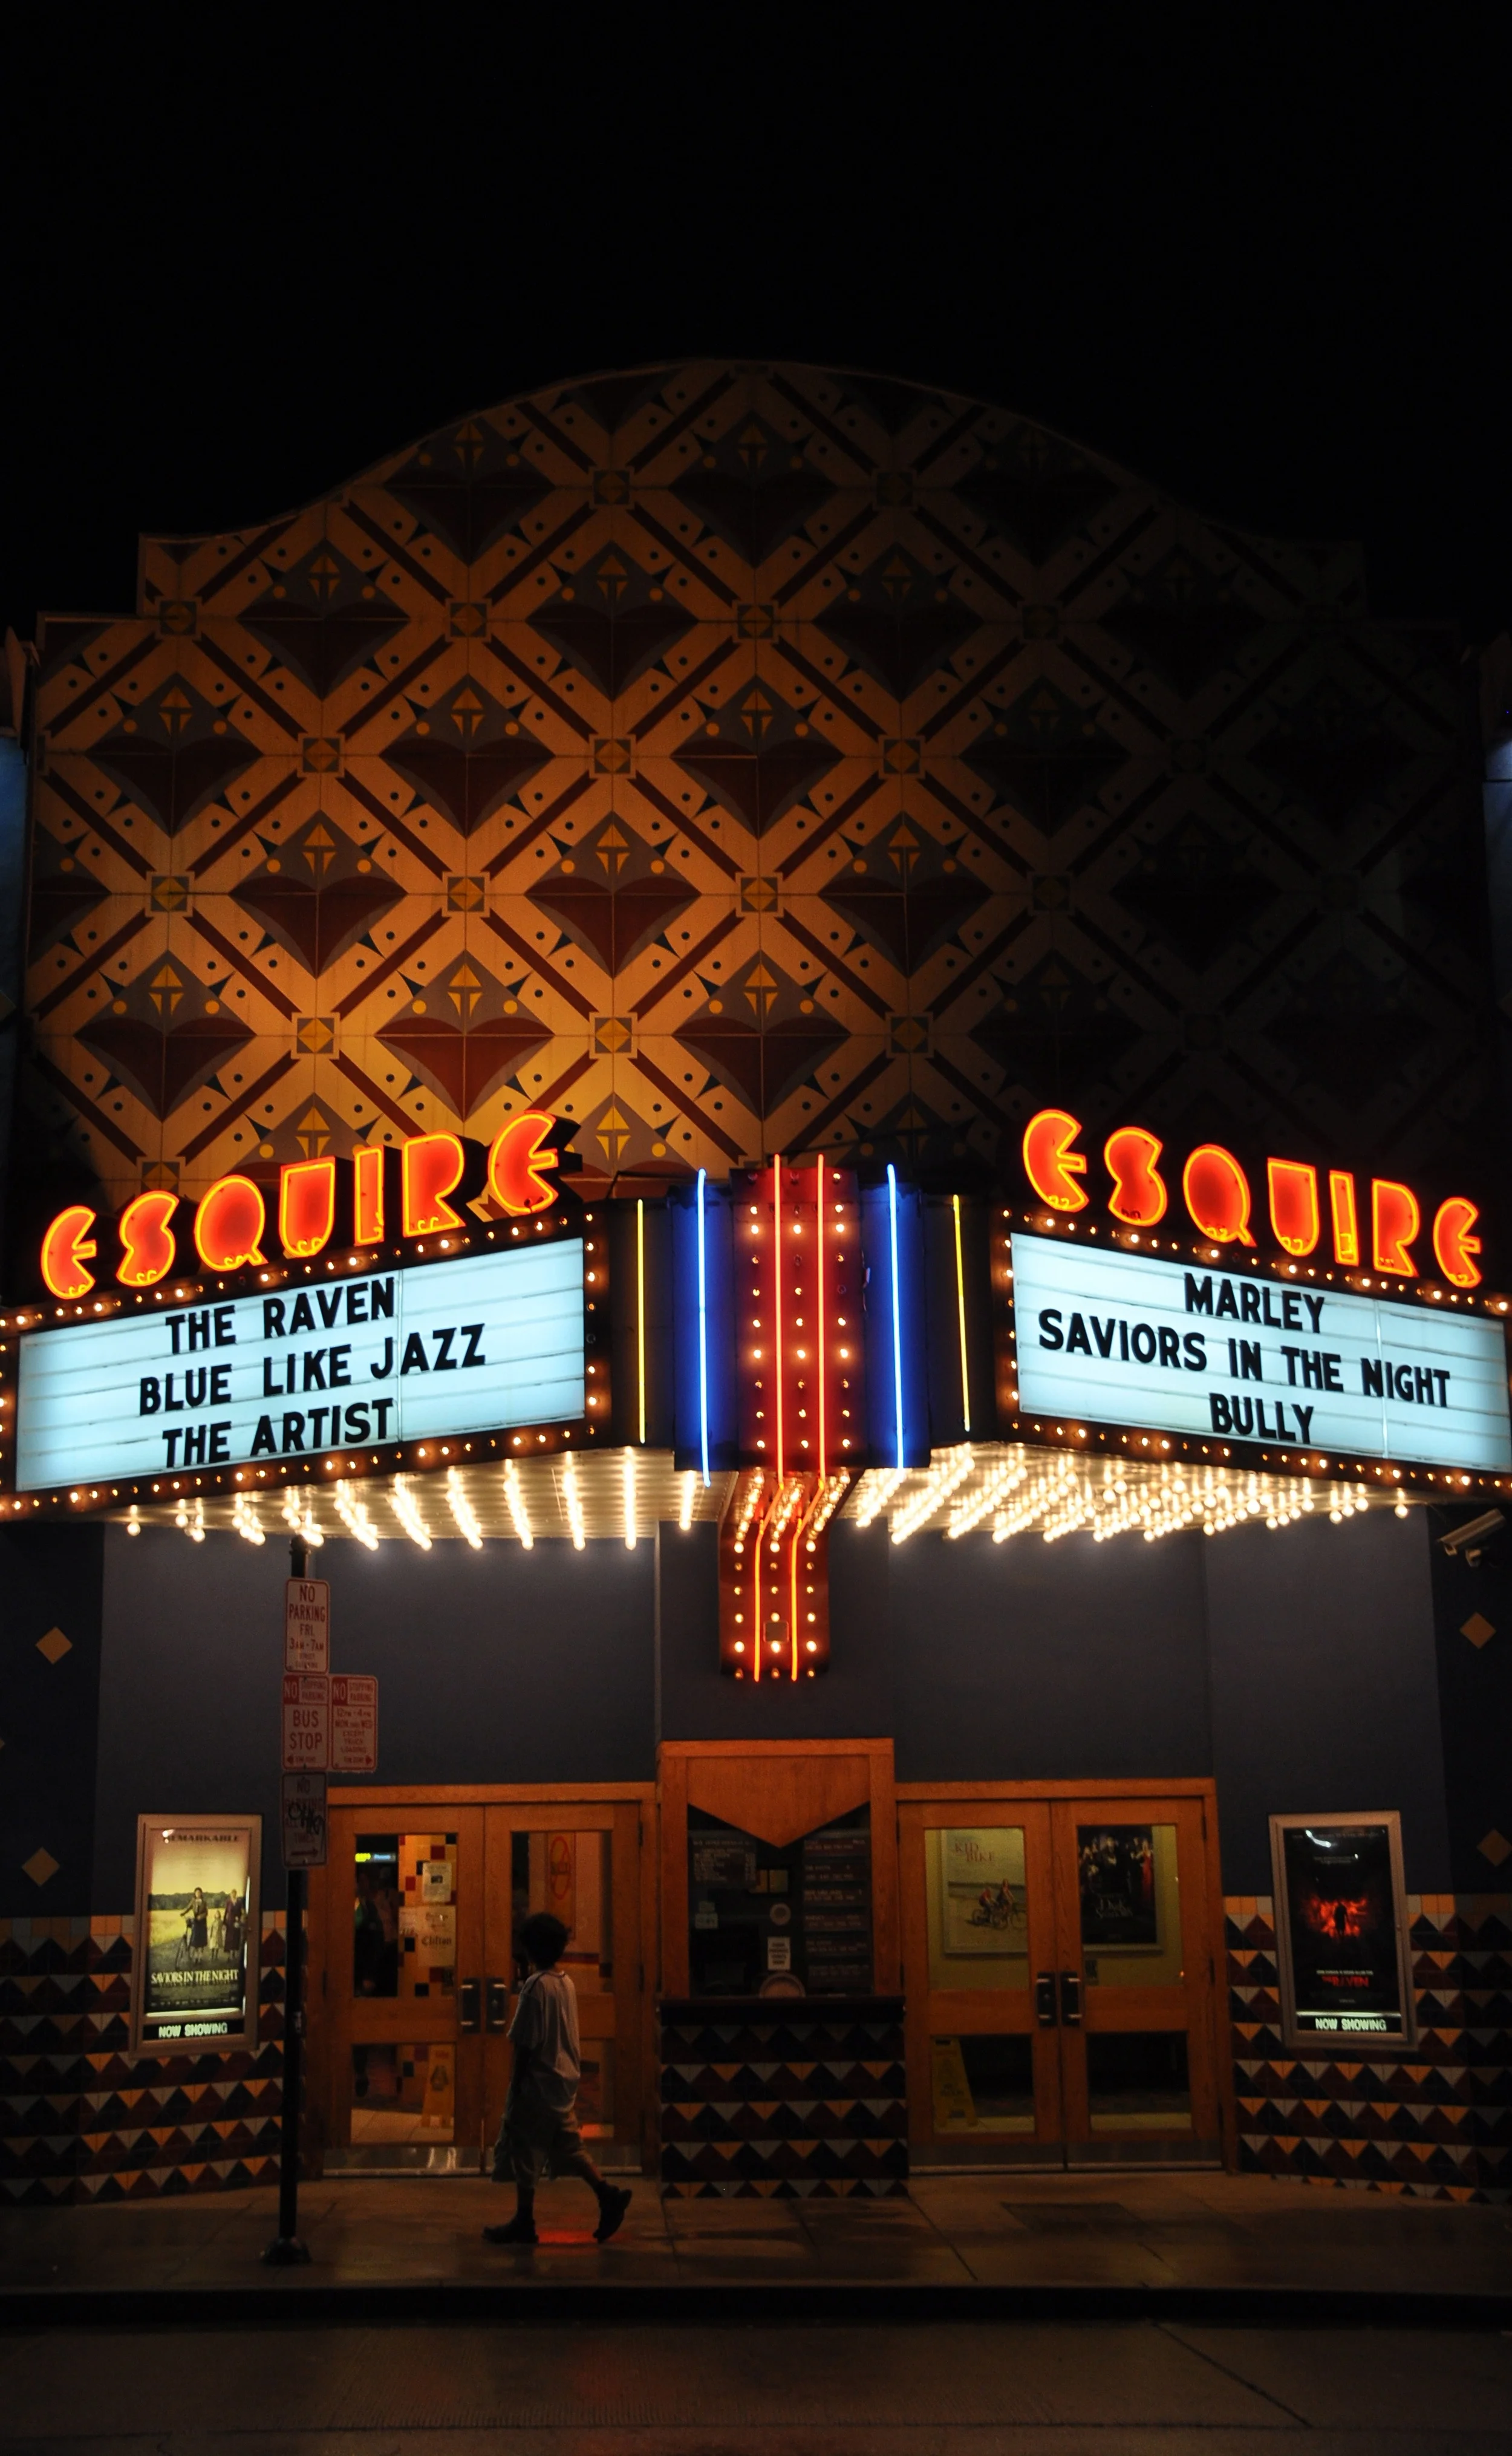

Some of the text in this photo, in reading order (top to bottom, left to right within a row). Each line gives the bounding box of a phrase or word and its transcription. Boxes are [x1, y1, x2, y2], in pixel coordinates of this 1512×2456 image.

[41, 1110, 560, 1299] ESQUIRE
[1023, 1109, 1482, 1288] ESQUIRE
[1184, 1272, 1325, 1334] MARLEY
[165, 1277, 394, 1355] THE RAVEN
[1038, 1309, 1451, 1408] SAVIORS IN THE NIGHT
[139, 1323, 485, 1416] BLUE LIKE JAZZ
[1208, 1392, 1314, 1444] BULLY
[162, 1398, 393, 1468] THE ARTIST
[299, 1585, 316, 1603] NO
[288, 1603, 325, 1622] PARKING
[284, 1681, 298, 1699] NO
[333, 1683, 346, 1701] NO
[293, 1709, 319, 1728] BUS
[290, 1732, 323, 1750] STOP
[296, 1779, 311, 1794] NO
[151, 1971, 183, 1984] SAVIORS
[183, 1970, 194, 1983] IN
[195, 1970, 211, 1982] THE
[212, 1969, 239, 1981] NIGHT
[158, 2022, 228, 2039] NOW SHOWING
[1315, 2018, 1387, 2032] NOW SHOWING
